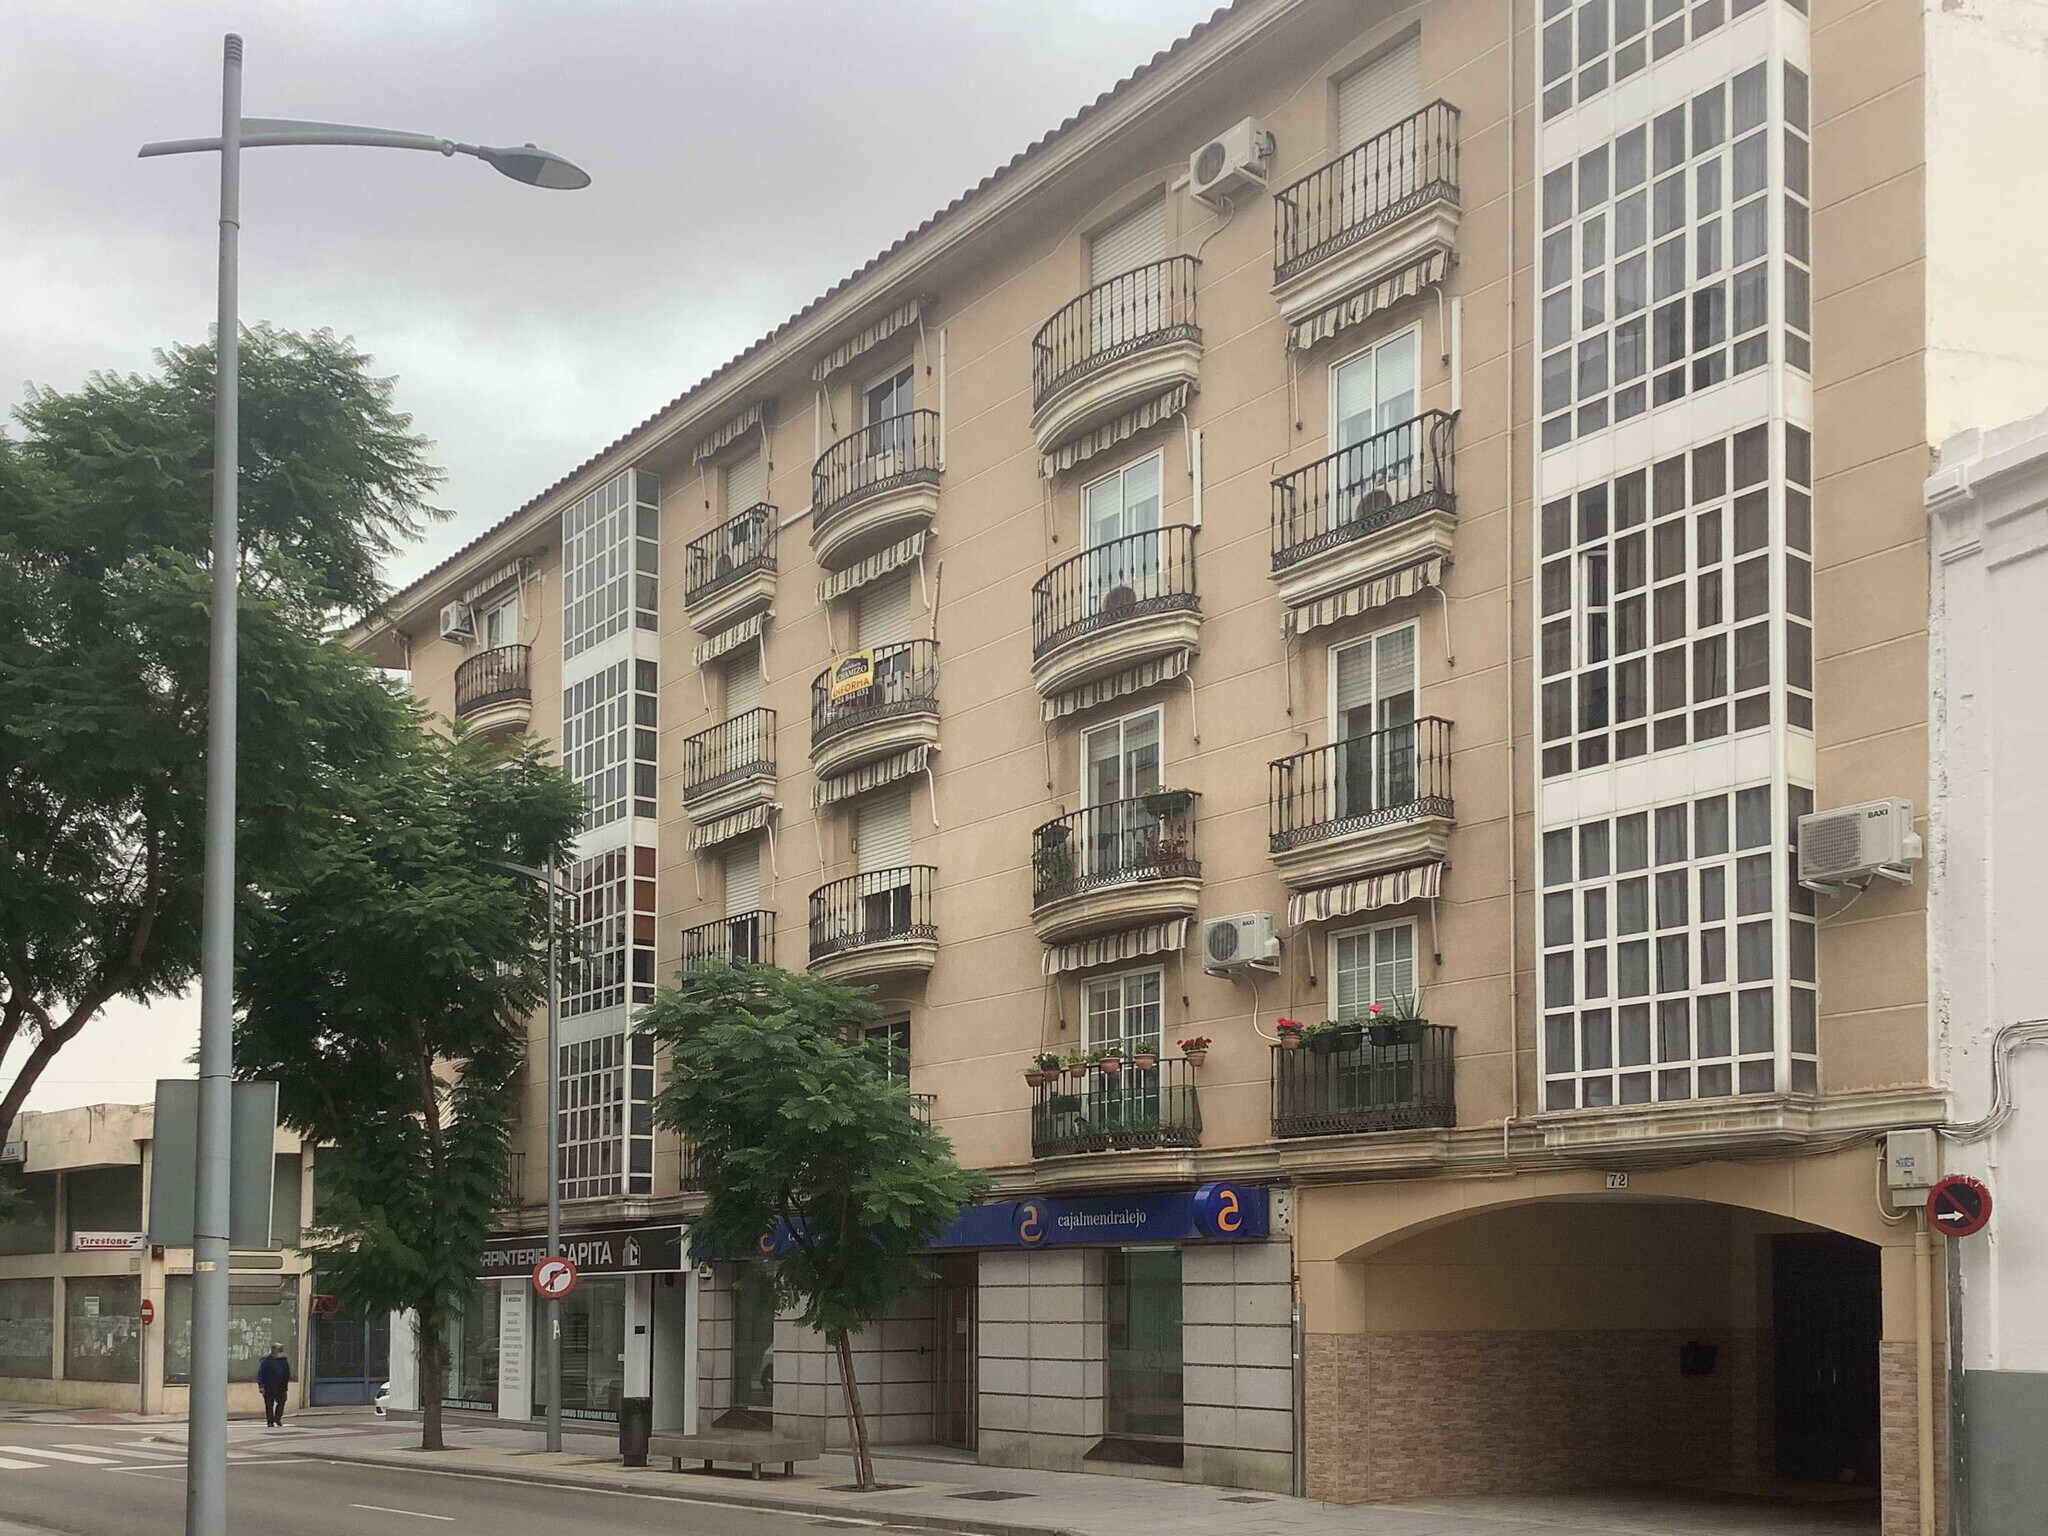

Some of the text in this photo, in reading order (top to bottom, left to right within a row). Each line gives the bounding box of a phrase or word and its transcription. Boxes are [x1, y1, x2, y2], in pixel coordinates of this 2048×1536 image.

[833, 678, 870, 698] INFORMA
[1868, 809, 1888, 818] BAXI
[1610, 1174, 1626, 1187] 72
[1057, 1208, 1147, 1230] cajalmendralejo
[79, 1236, 129, 1246] Firestone
[480, 1248, 547, 1267] RPINTERIA
